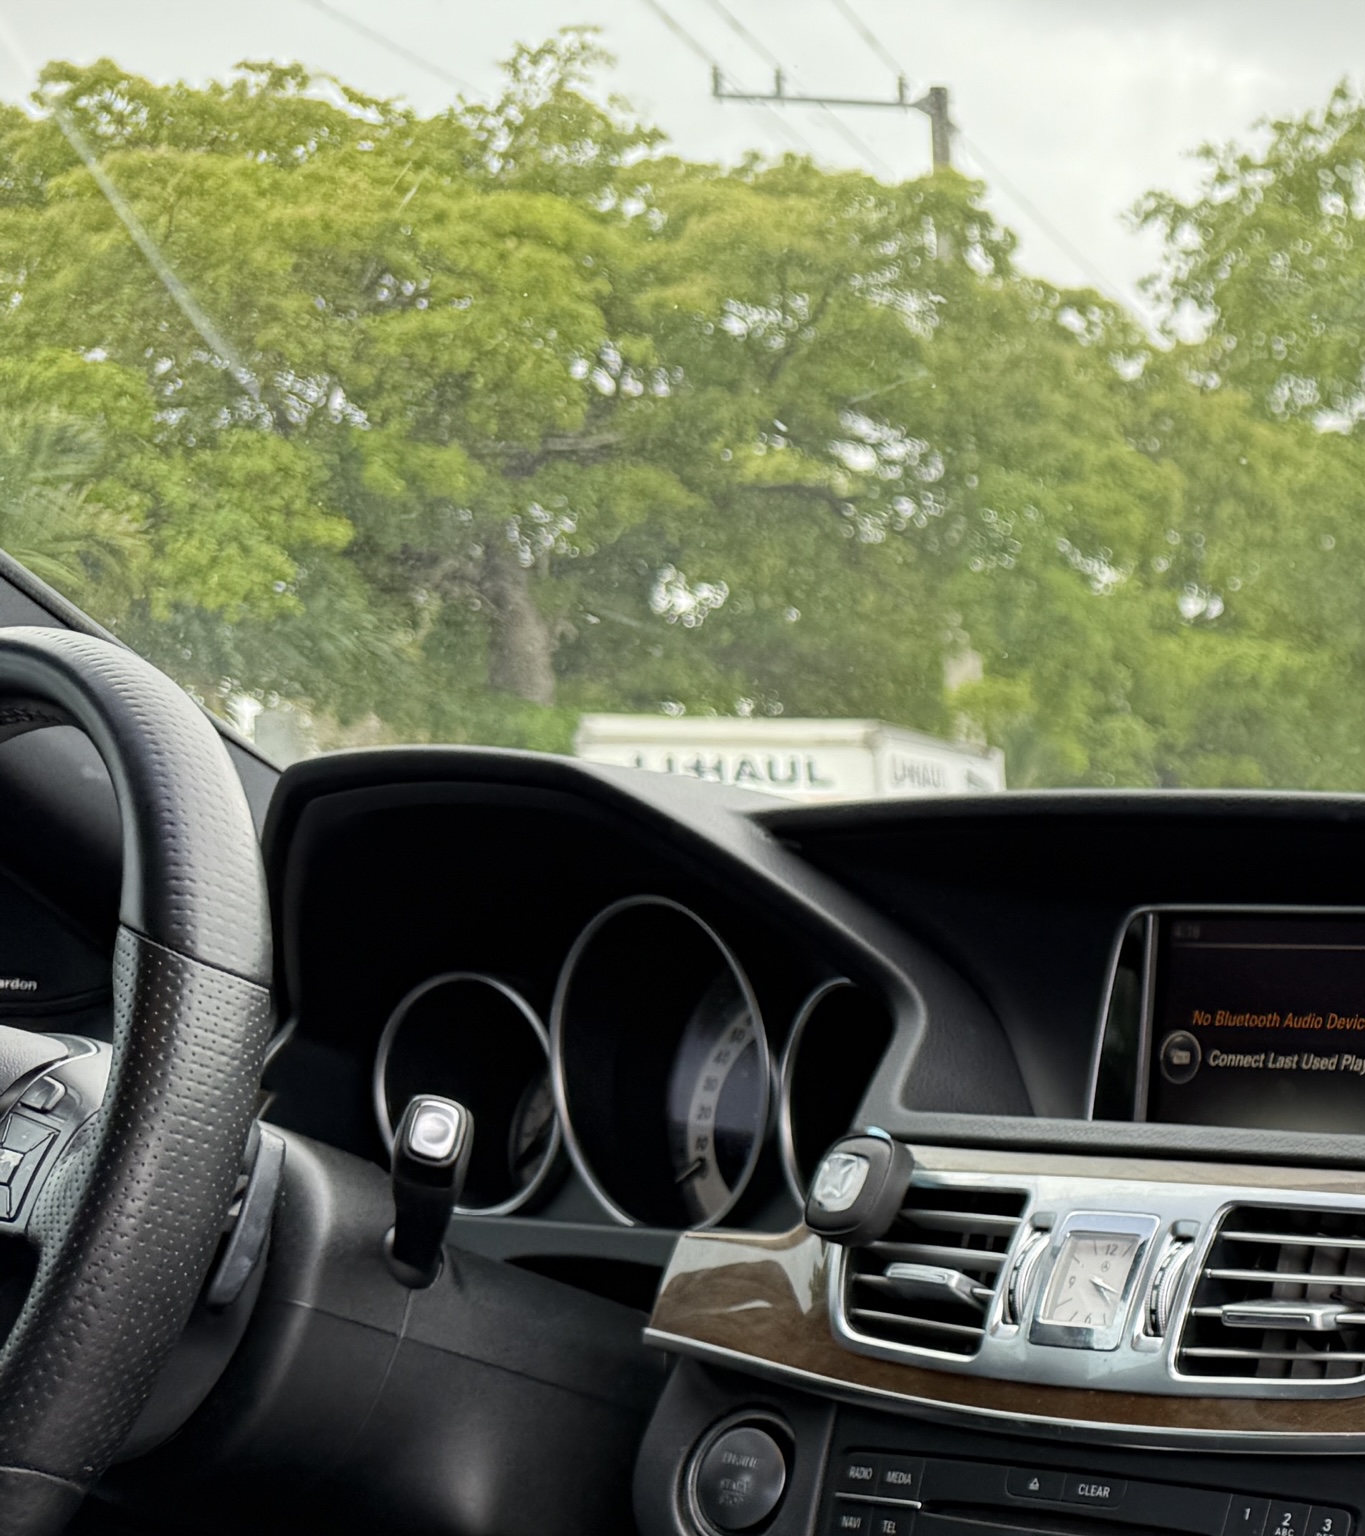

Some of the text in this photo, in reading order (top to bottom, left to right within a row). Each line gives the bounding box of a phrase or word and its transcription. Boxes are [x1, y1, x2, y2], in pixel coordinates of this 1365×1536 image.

[1192, 1010, 1212, 1026] No
[1214, 1010, 1280, 1028] Bluetooth
[1283, 1012, 1323, 1029] Audio
[1208, 1050, 1265, 1069] Connect
[1267, 1052, 1299, 1071] Last
[1301, 1053, 1338, 1072] Used
[1104, 1243, 1119, 1257] 12
[1068, 1275, 1077, 1289] 9
[848, 1465, 873, 1480] RADIO
[885, 1470, 912, 1485] MEDIA
[1078, 1483, 1111, 1498] CLEAR
[1244, 1507, 1251, 1520] 1
[1281, 1512, 1292, 1527] 2
[882, 1520, 896, 1535] TEL
[1321, 1518, 1333, 1532] 3
